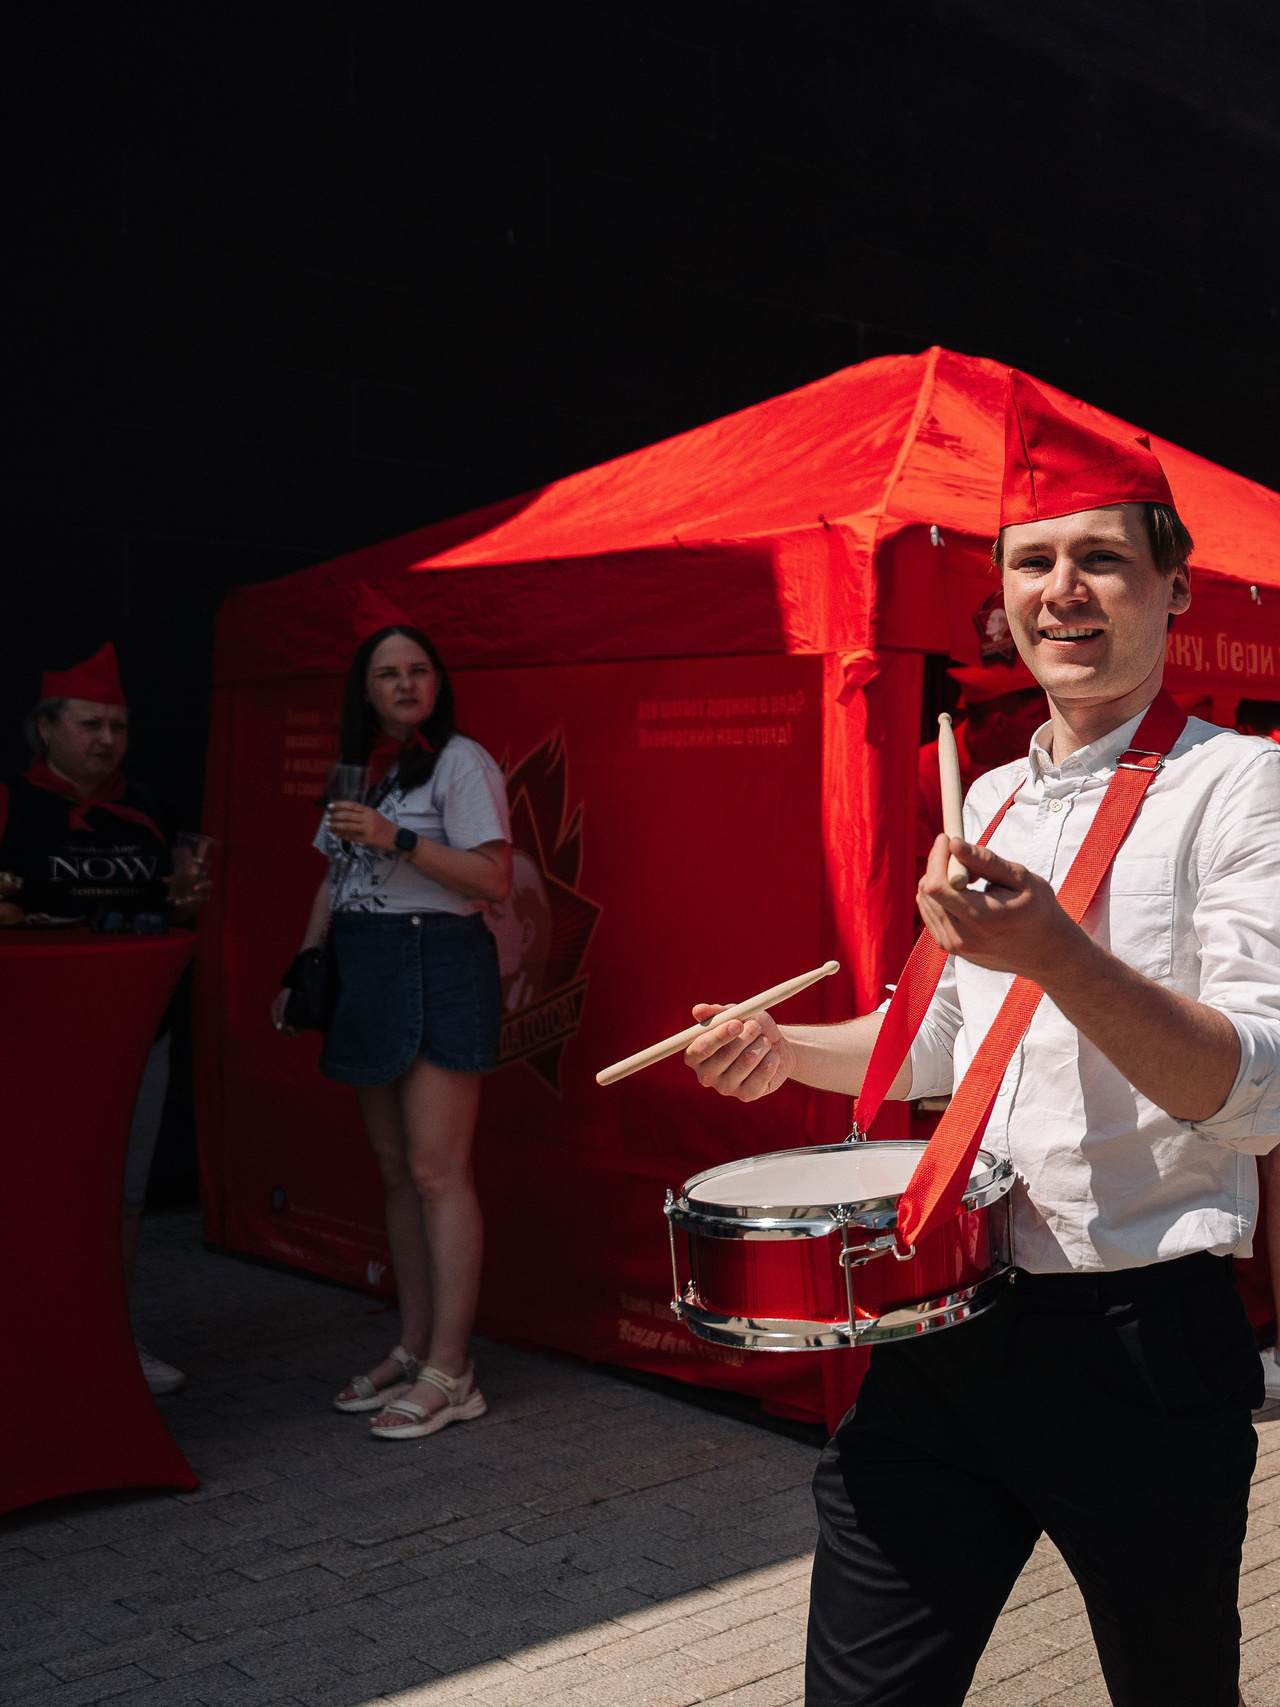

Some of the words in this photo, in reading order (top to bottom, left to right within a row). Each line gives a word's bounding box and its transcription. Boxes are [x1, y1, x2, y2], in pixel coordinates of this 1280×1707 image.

[1216, 632, 1275, 677] бери
[638, 723, 714, 749] Пионерский
[716, 728, 744, 746] наш
[746, 721, 792, 747] отряд!
[48, 855, 157, 881] NOW
